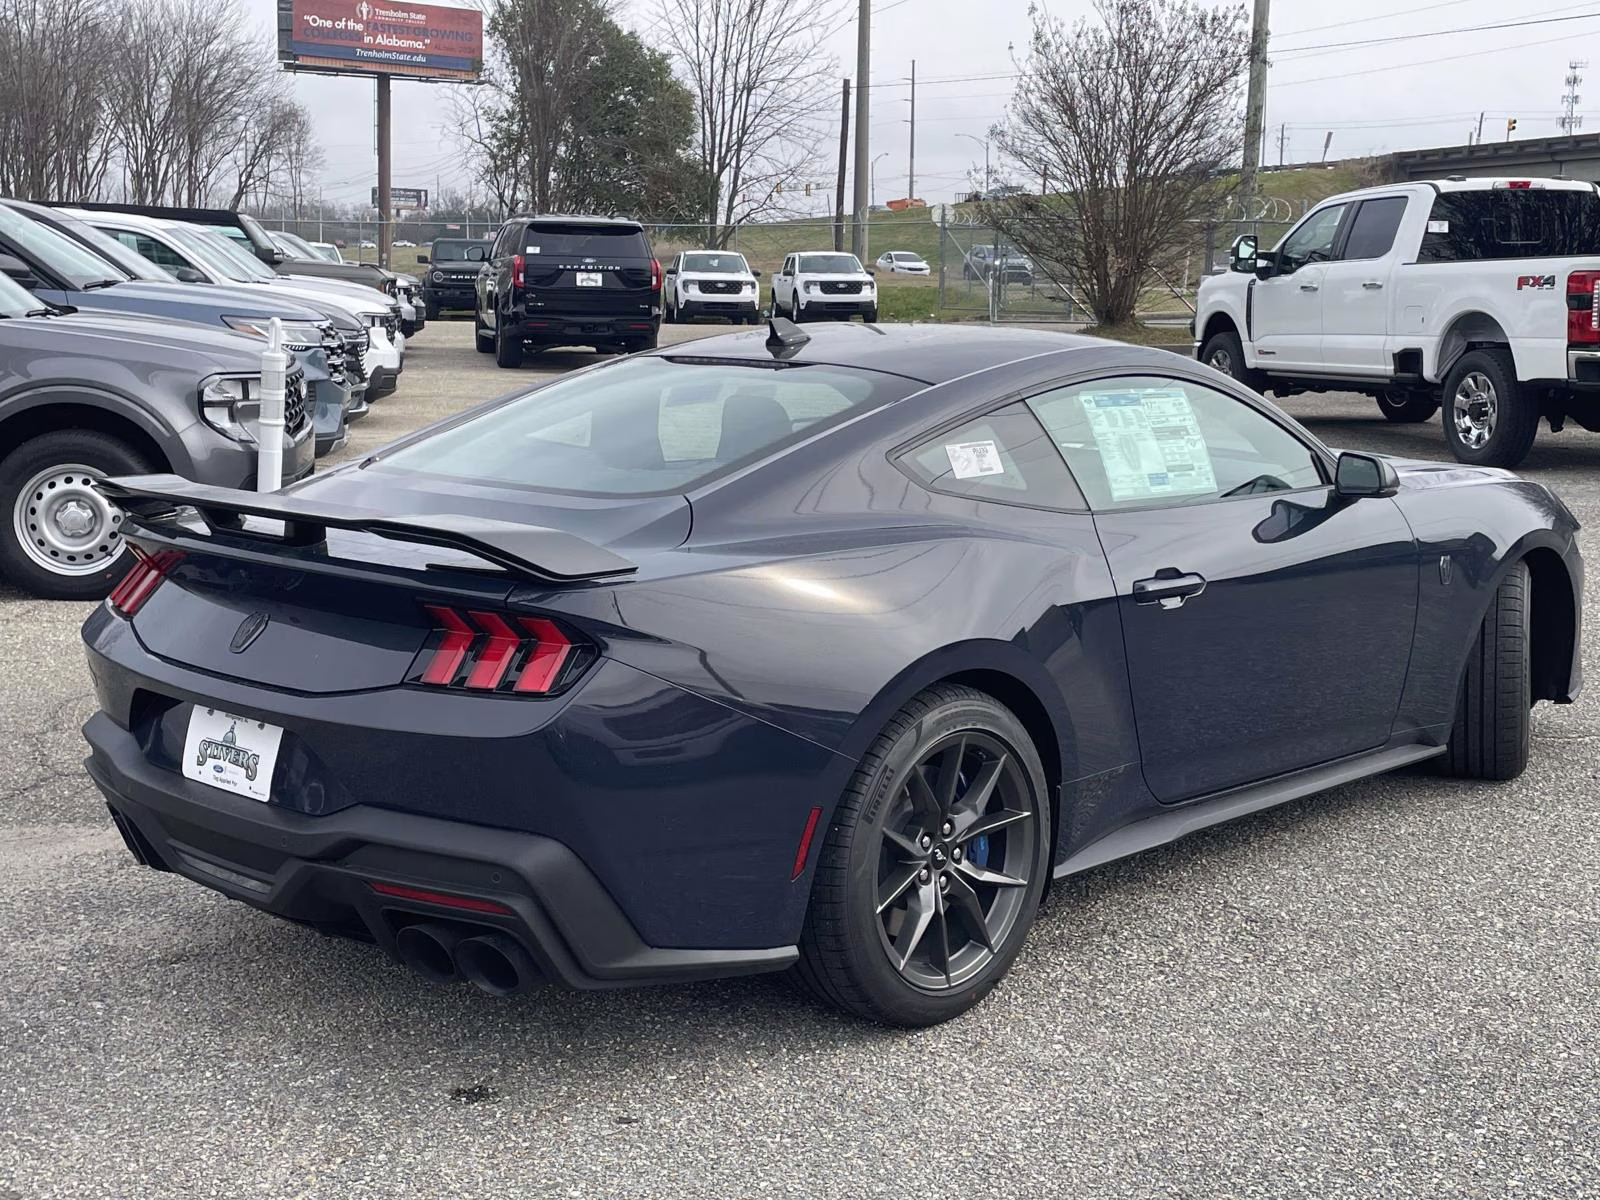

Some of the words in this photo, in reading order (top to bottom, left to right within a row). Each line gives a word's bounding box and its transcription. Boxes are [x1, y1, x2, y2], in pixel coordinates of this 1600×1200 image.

[375, 8, 409, 19] Trenholm
[409, 12, 427, 20] State
[334, 16, 346, 30] of
[347, 18, 364, 32] the
[363, 32, 373, 44] in
[356, 48, 427, 63] TrenholmState.edu
[1517, 275, 1556, 290] FX4
[196, 739, 260, 782] STIVERS
[862, 764, 896, 825] PIRELLI
